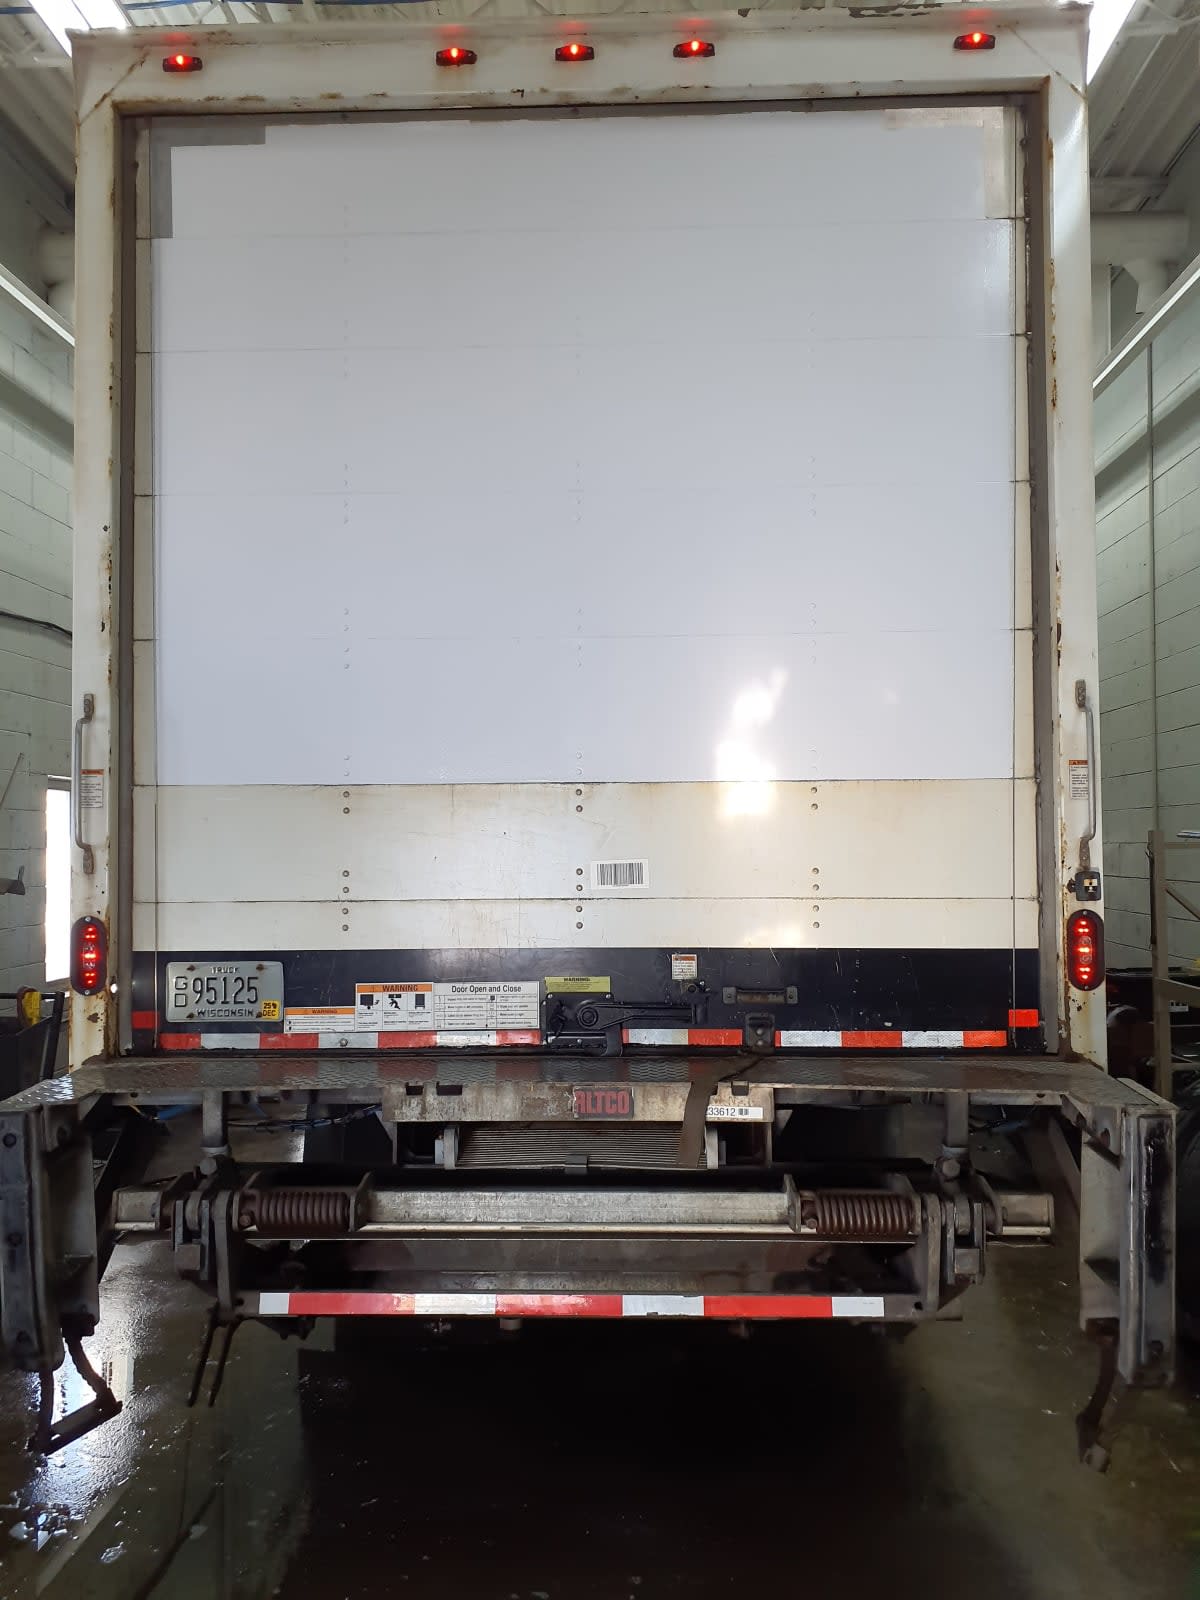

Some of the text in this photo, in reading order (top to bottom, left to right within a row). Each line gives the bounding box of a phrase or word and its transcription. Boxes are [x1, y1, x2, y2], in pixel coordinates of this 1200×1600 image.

[211, 966, 239, 974] TRUCK
[192, 976, 259, 1005] 95125
[382, 984, 418, 992] WARNING
[451, 984, 522, 995] Door Open and Close
[197, 1008, 254, 1017] WISCONSIN
[262, 1009, 277, 1017] DEC
